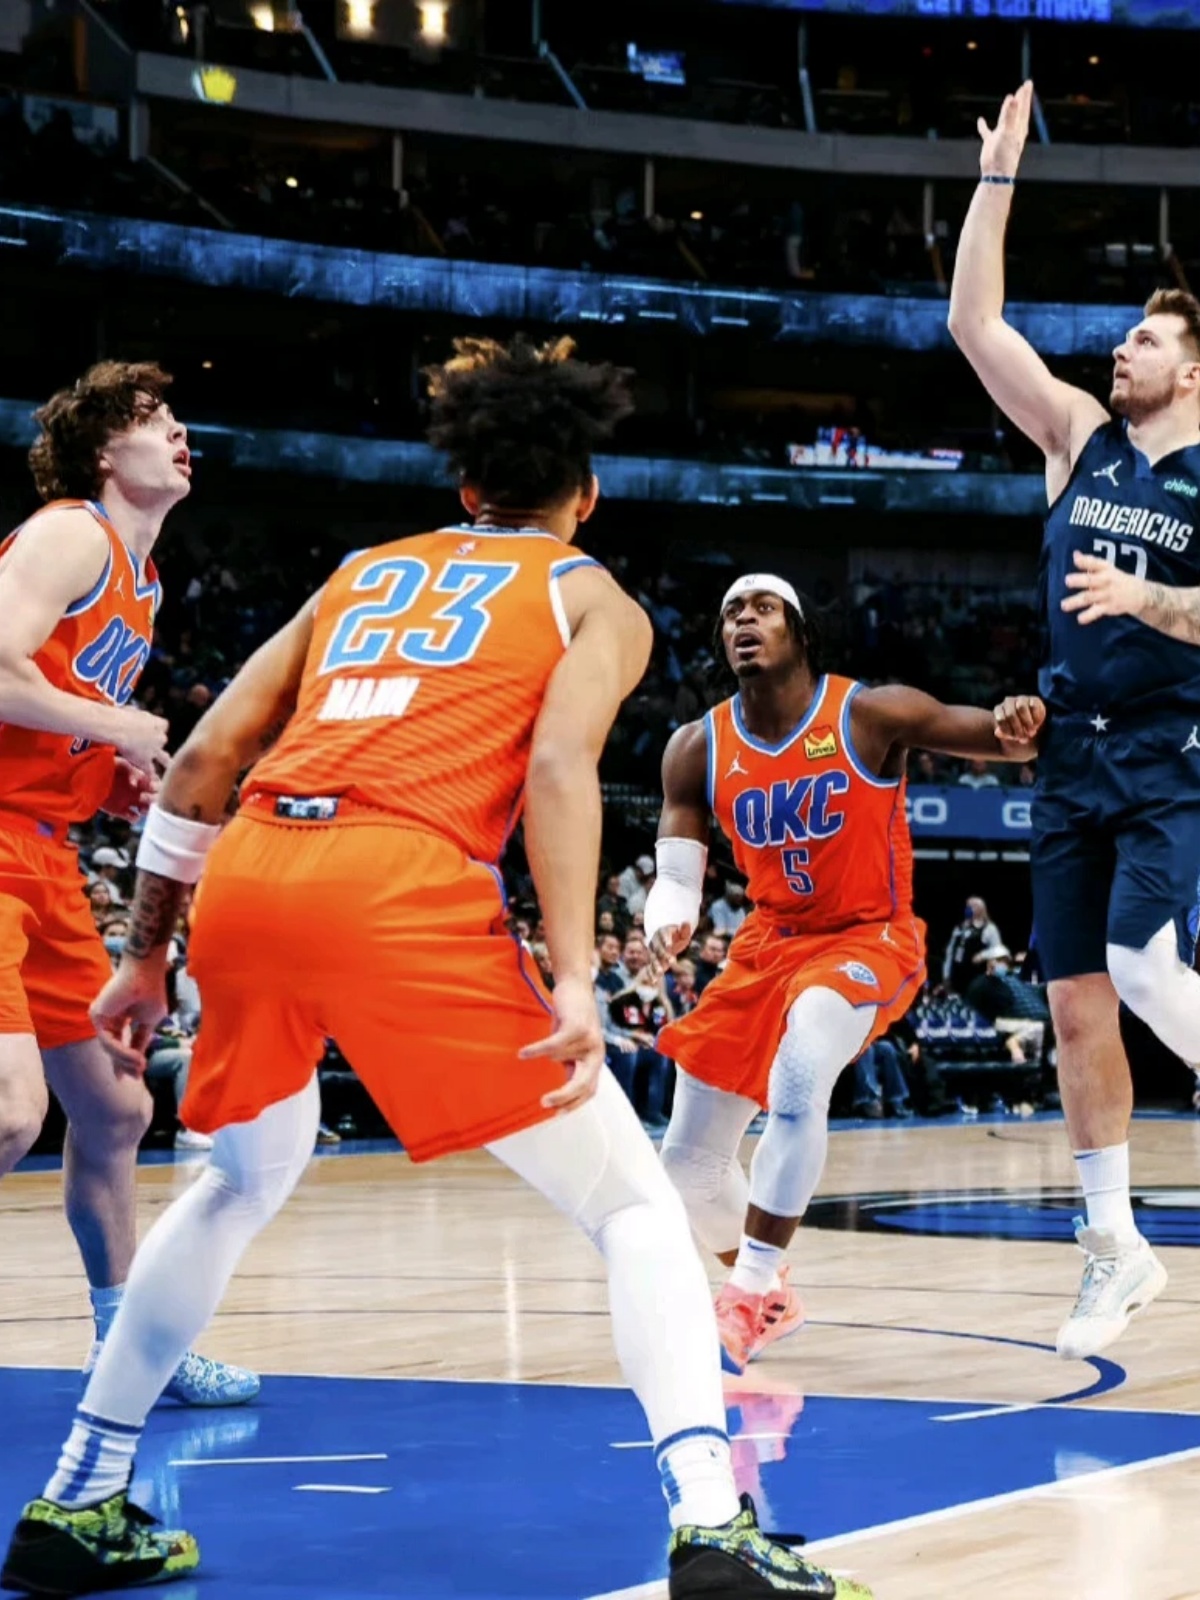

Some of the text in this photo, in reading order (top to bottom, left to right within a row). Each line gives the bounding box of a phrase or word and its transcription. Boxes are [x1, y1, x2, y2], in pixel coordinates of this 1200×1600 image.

[1164, 478, 1199, 497] chime
[1069, 495, 1194, 553] MAVERICKS
[318, 556, 520, 676] 23
[733, 769, 849, 848] OKC
[781, 848, 814, 895] 5
